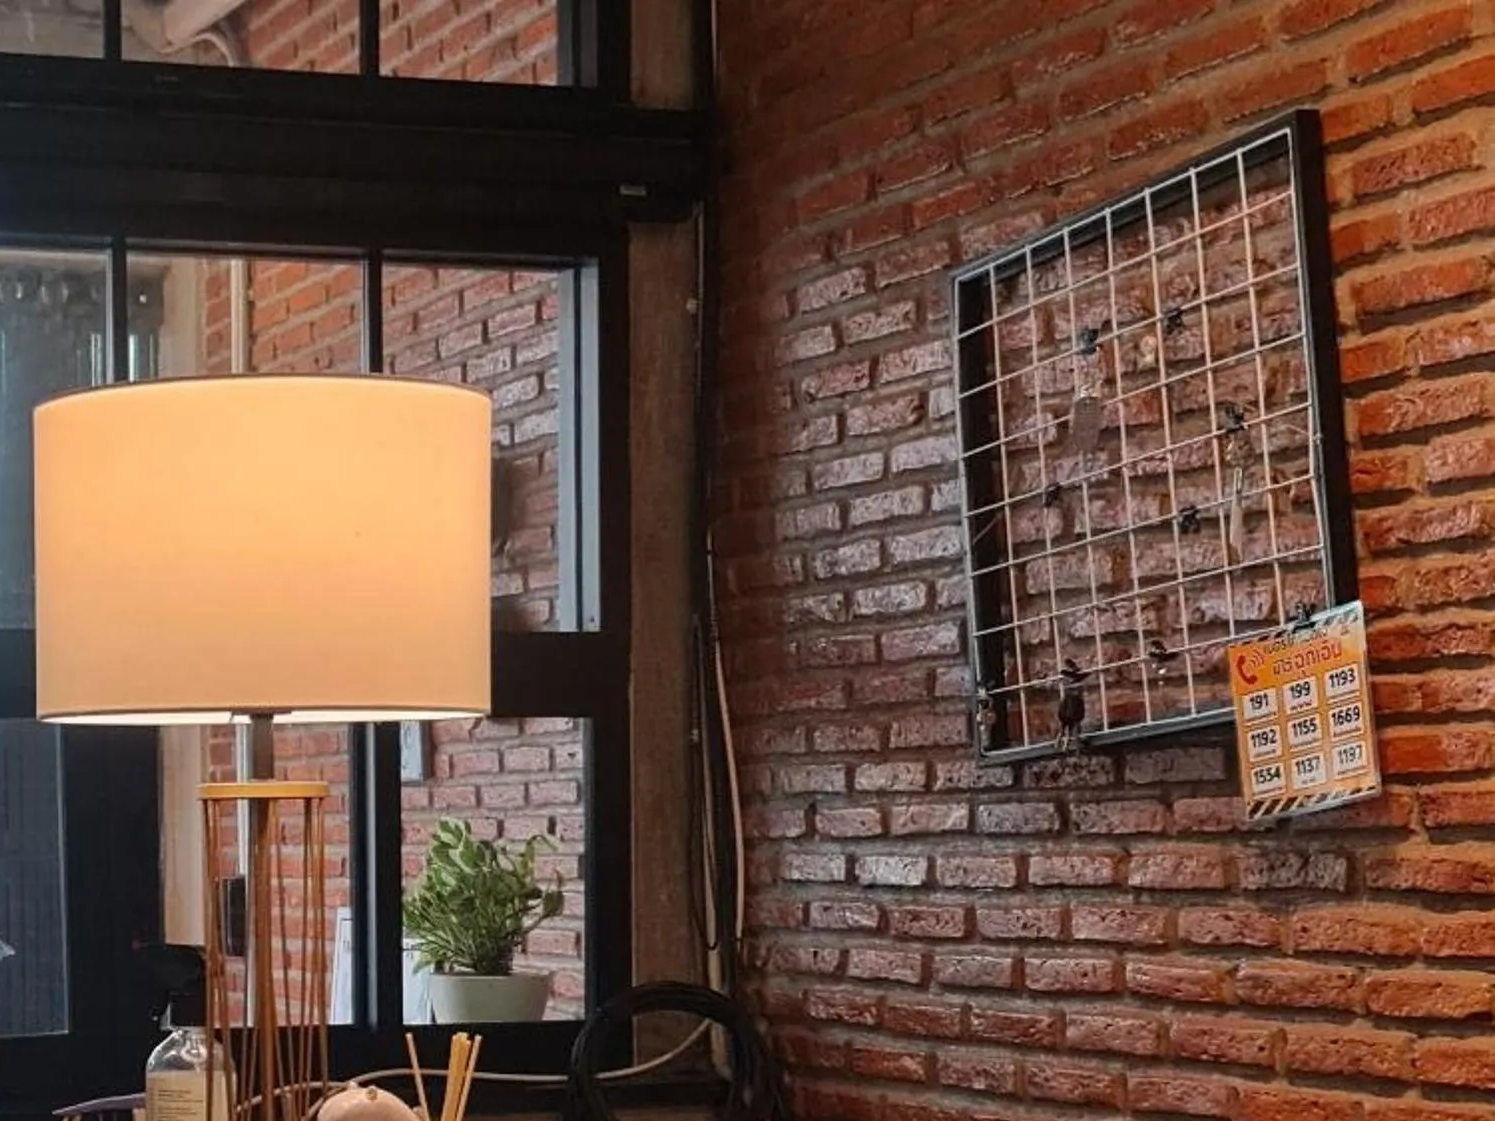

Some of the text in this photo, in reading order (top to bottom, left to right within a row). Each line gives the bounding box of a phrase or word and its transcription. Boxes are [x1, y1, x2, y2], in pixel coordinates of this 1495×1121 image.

[1329, 667, 1356, 688] 1193
[1290, 681, 1310, 699] 199
[1331, 705, 1360, 726] 1669
[1292, 717, 1317, 737] 1155
[1251, 729, 1277, 748] 1192
[1295, 756, 1320, 775] 1137
